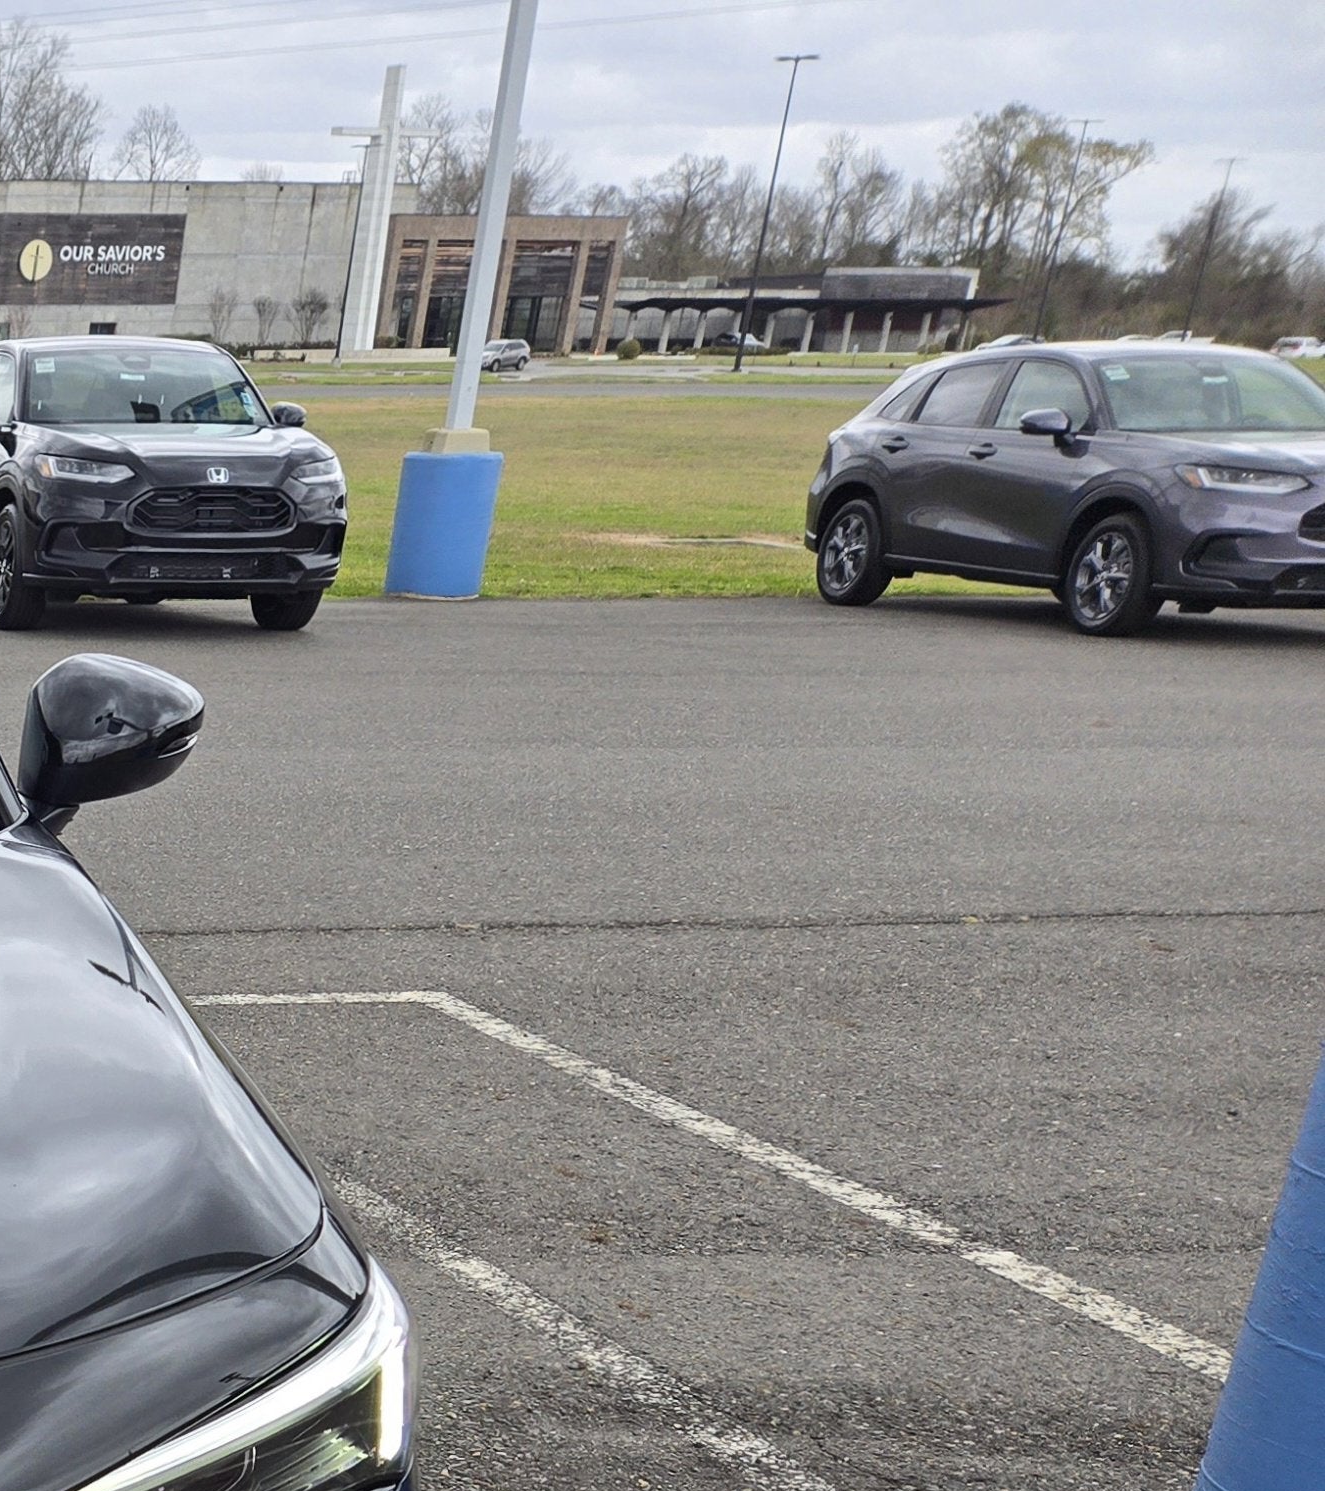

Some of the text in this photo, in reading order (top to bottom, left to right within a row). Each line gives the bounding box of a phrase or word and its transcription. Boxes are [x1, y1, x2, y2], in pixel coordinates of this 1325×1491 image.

[60, 245, 166, 262] OUR SAVIOR'S
[87, 263, 134, 275] CHURCH
